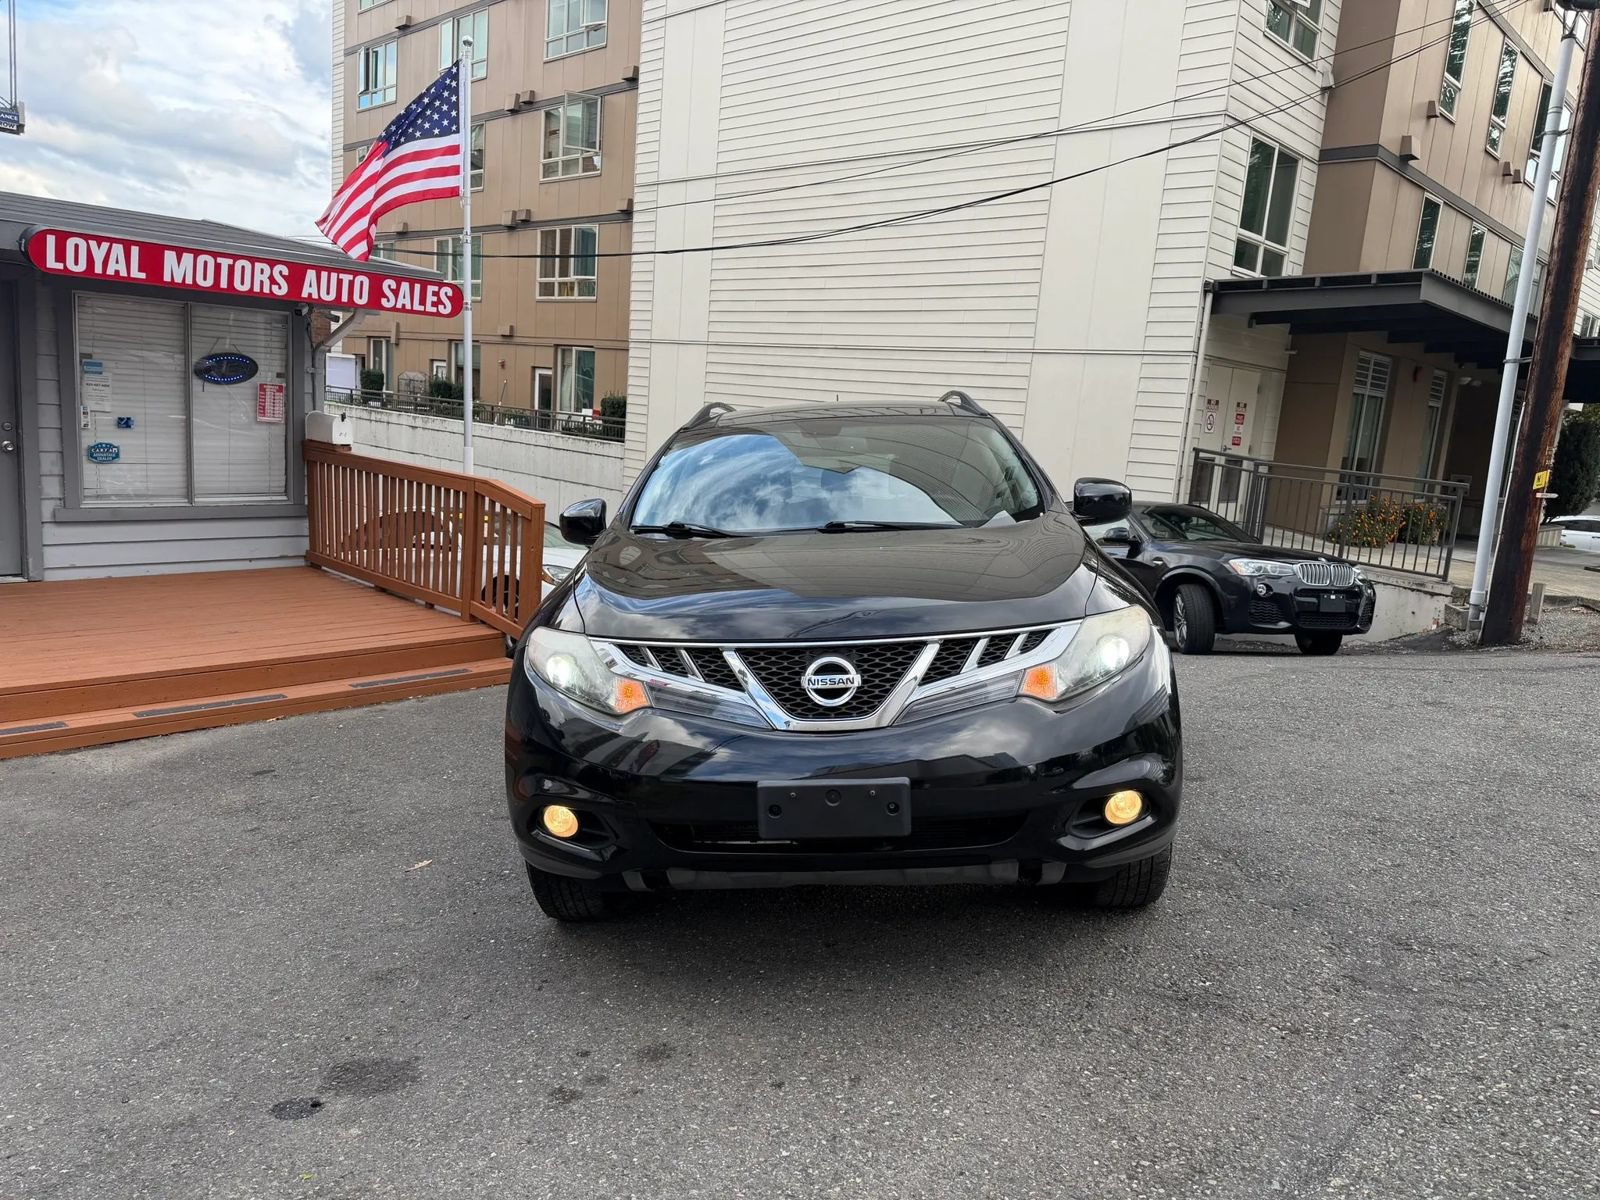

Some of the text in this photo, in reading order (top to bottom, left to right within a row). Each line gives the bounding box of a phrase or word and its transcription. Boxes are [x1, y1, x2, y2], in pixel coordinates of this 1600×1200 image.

[45, 234, 453, 315] LOYAL MOTORS AUTO SALES
[807, 677, 855, 686] NISSAN
